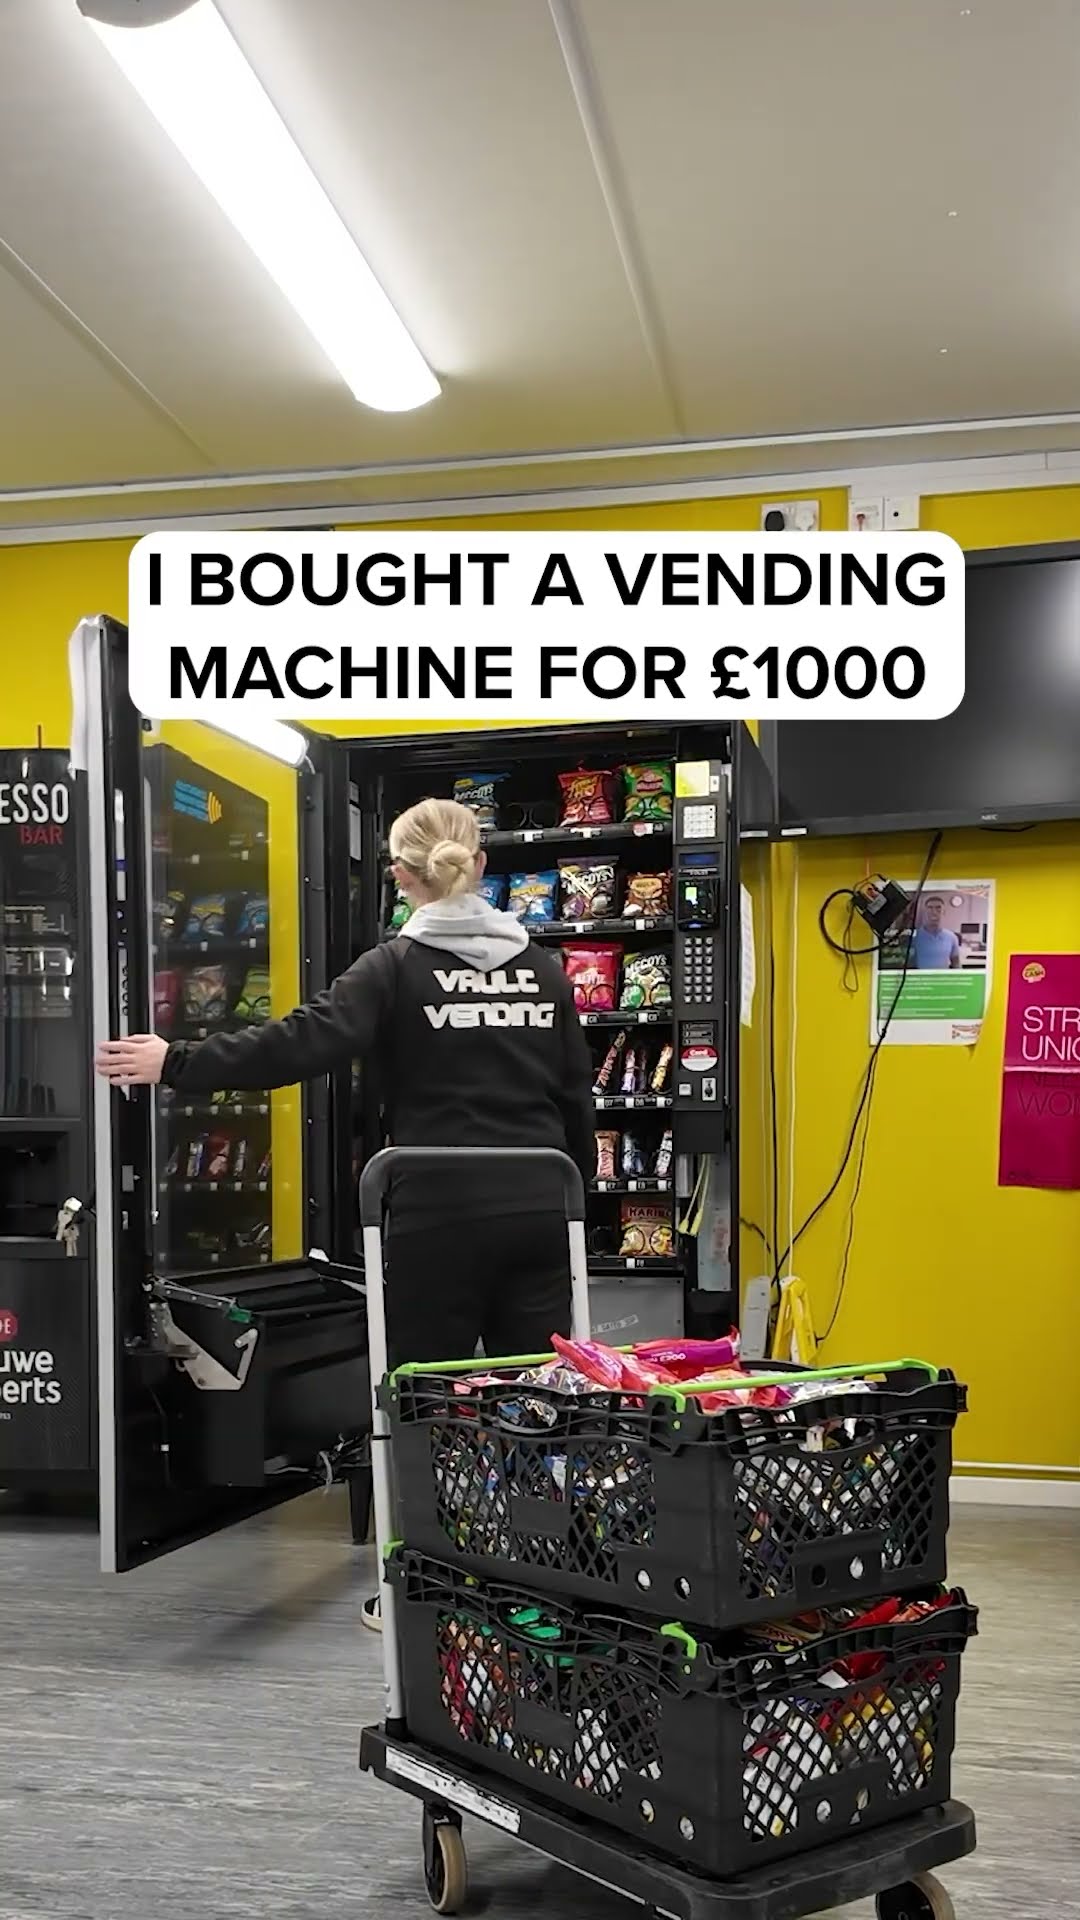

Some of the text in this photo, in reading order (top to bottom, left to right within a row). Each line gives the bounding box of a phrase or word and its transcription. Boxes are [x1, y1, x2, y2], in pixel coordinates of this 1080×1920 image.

[20, 826, 64, 845] BAR
[432, 969, 540, 994] VAULT
[423, 1002, 555, 1029] VENDING
[1023, 1006, 1080, 1033] STR
[1018, 1089, 1080, 1118] WO
[0, 1376, 61, 1404] erts
